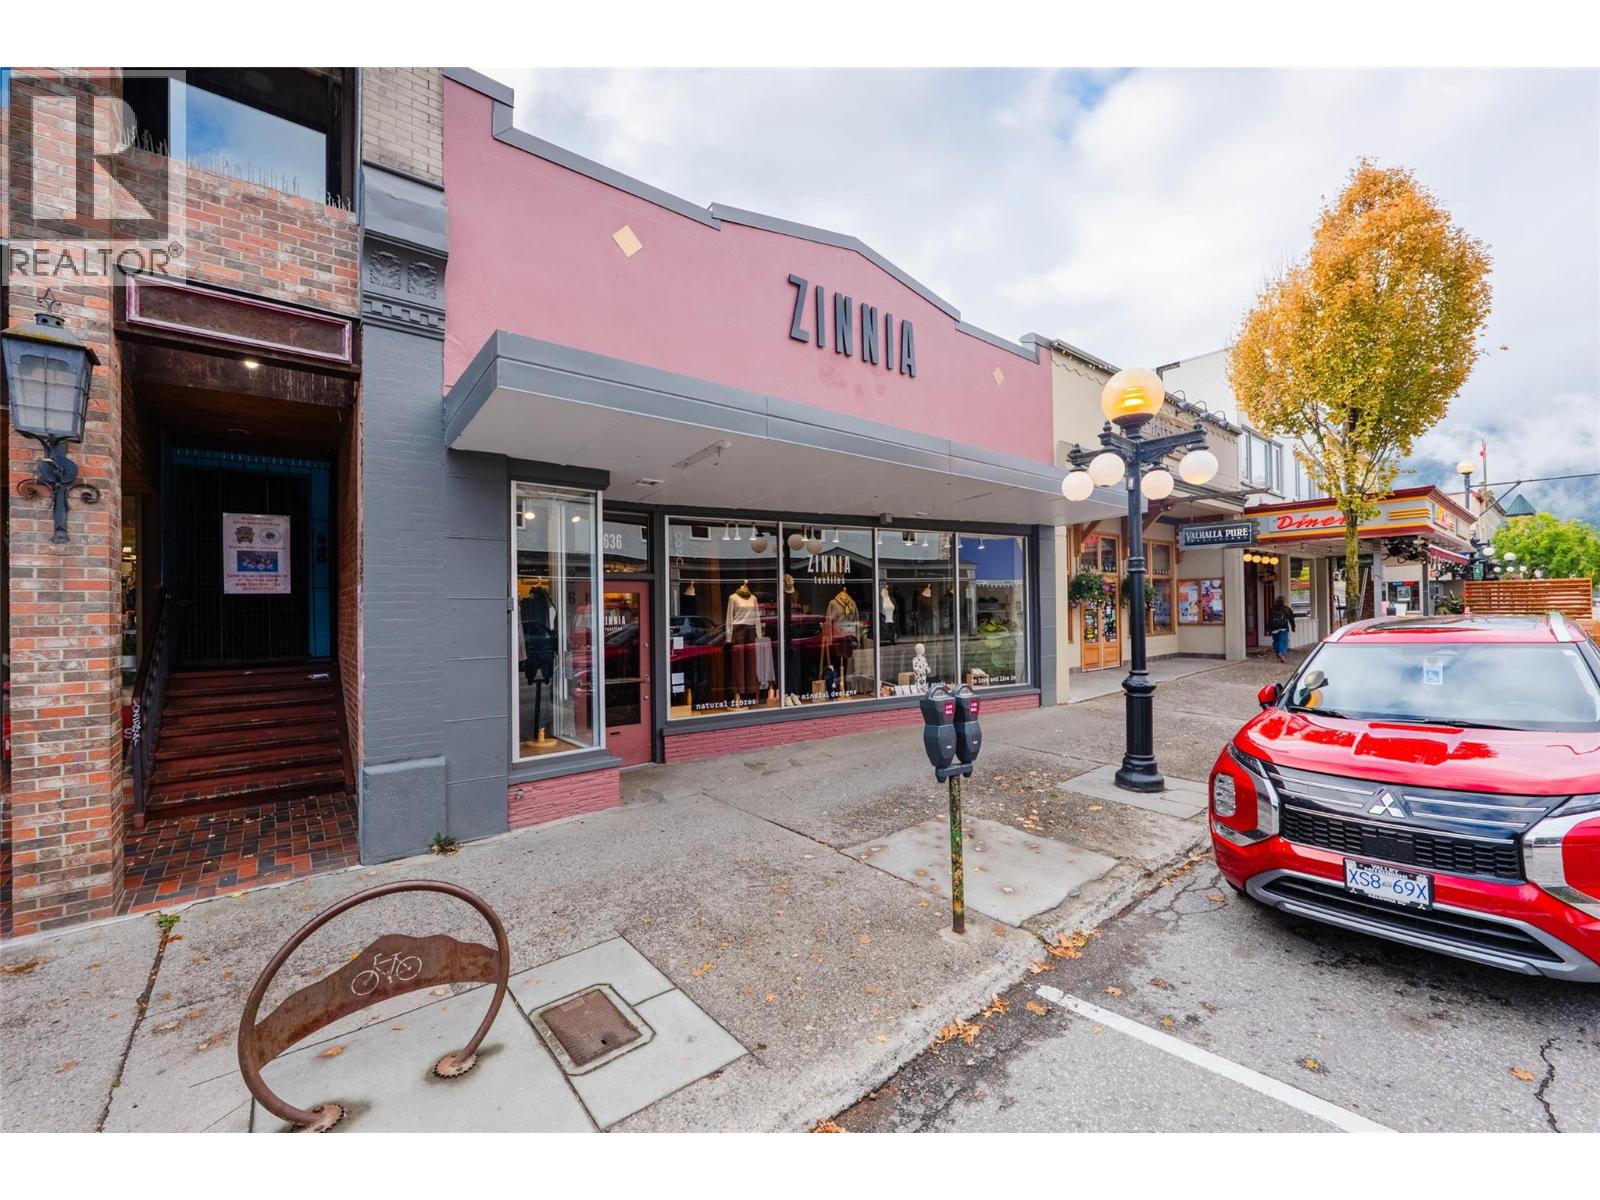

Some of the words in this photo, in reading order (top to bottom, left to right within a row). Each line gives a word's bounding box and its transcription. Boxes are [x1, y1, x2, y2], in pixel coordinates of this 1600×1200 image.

[787, 273, 917, 379] ZINNIA
[602, 533, 622, 550] 636
[1185, 529, 1223, 543] VALHALLA
[1225, 527, 1249, 537] PURE
[807, 554, 851, 574] ZINNIA
[813, 575, 846, 585] textiles
[603, 615, 626, 626] INNIA
[801, 691, 829, 700] mindful
[830, 689, 857, 698] designs
[695, 700, 728, 710] natural
[730, 698, 756, 707] fibres
[1348, 868, 1381, 889] XS8
[1392, 879, 1427, 901] 69X
